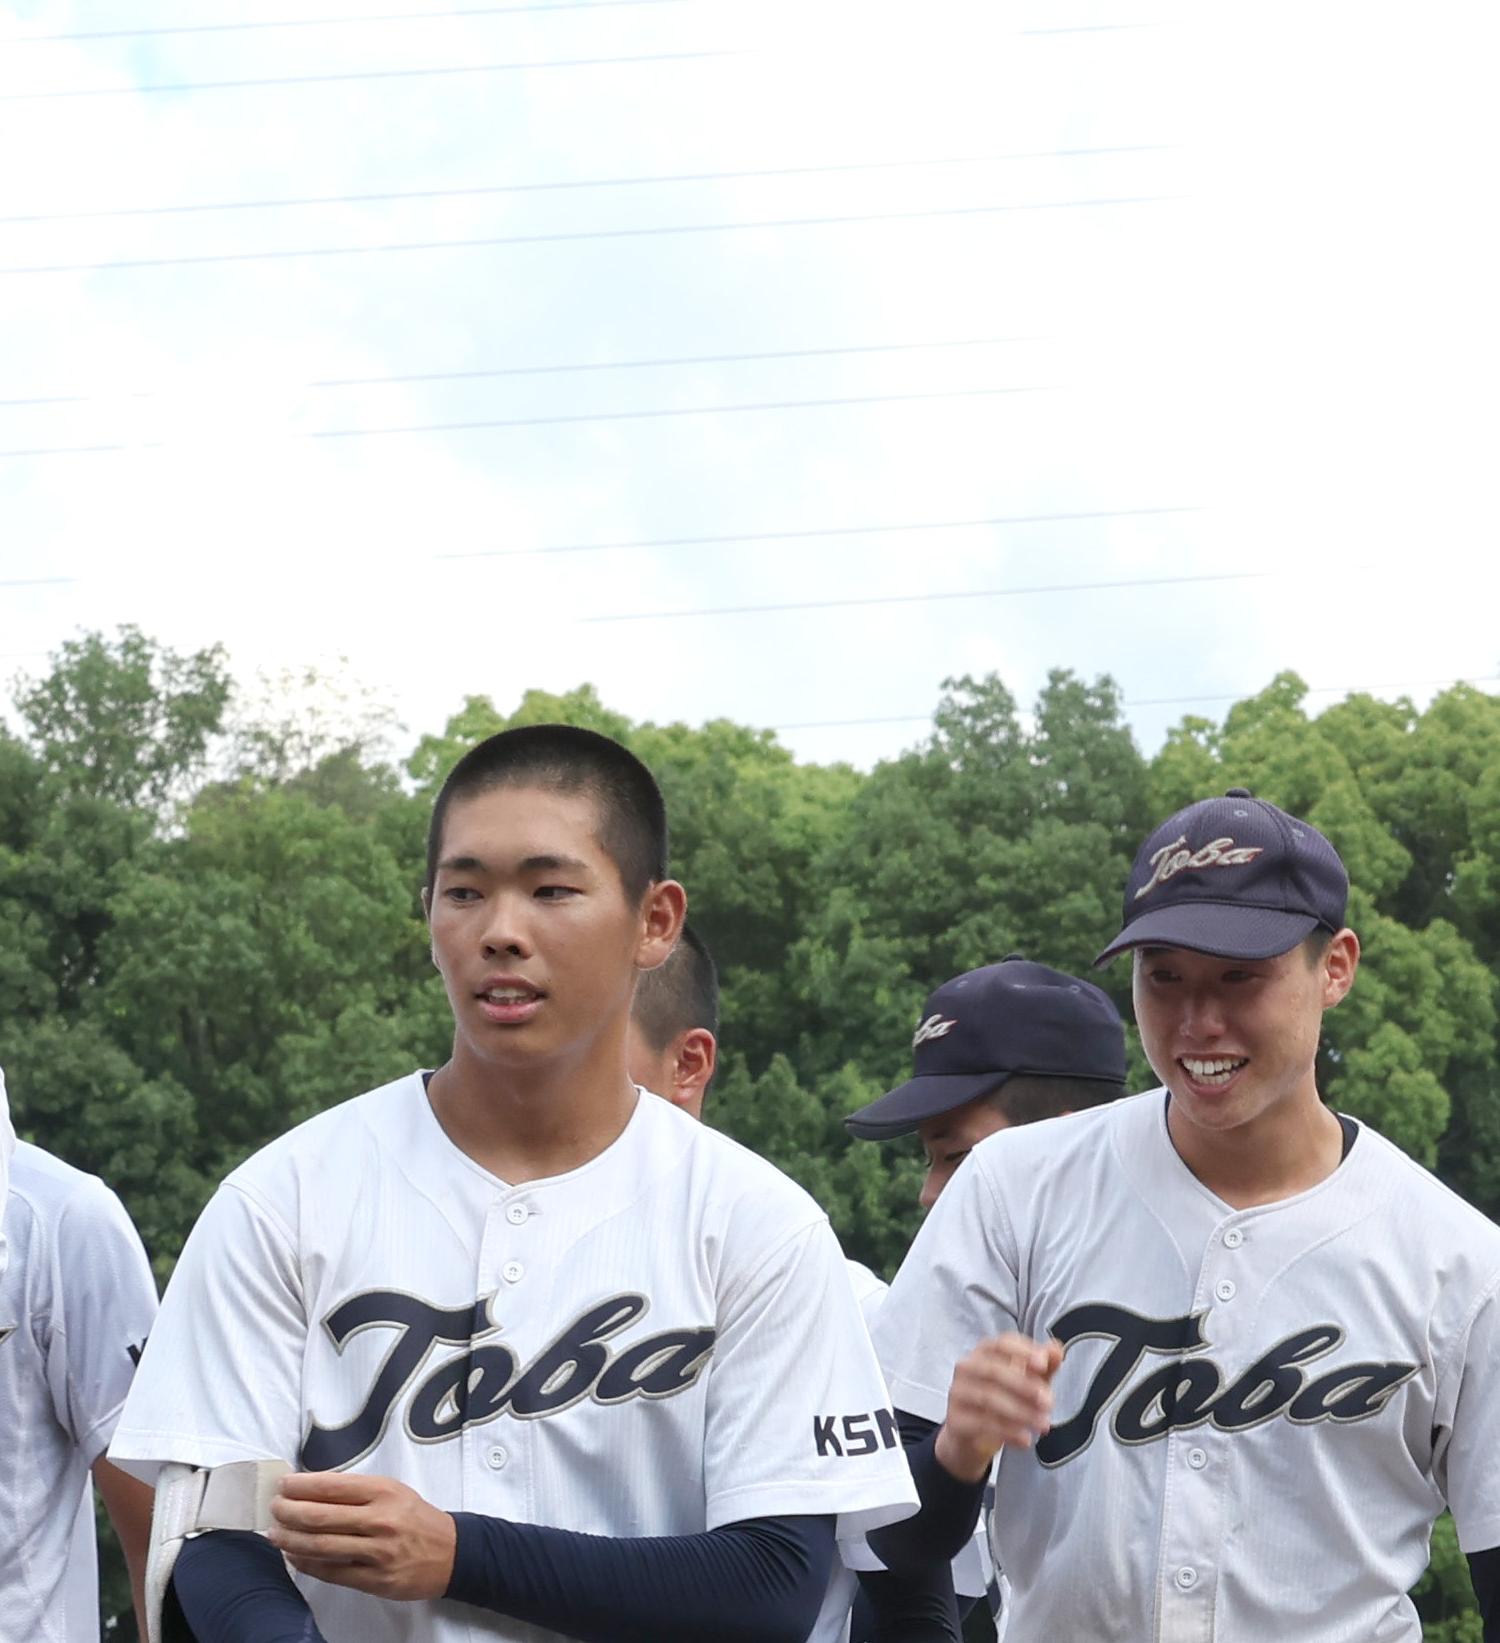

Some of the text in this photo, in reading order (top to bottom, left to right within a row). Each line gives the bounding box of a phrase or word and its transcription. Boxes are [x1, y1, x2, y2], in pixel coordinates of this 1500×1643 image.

[1134, 835, 1264, 899] Toba
[300, 1287, 716, 1473] Toba
[1035, 1301, 1427, 1469] Toba
